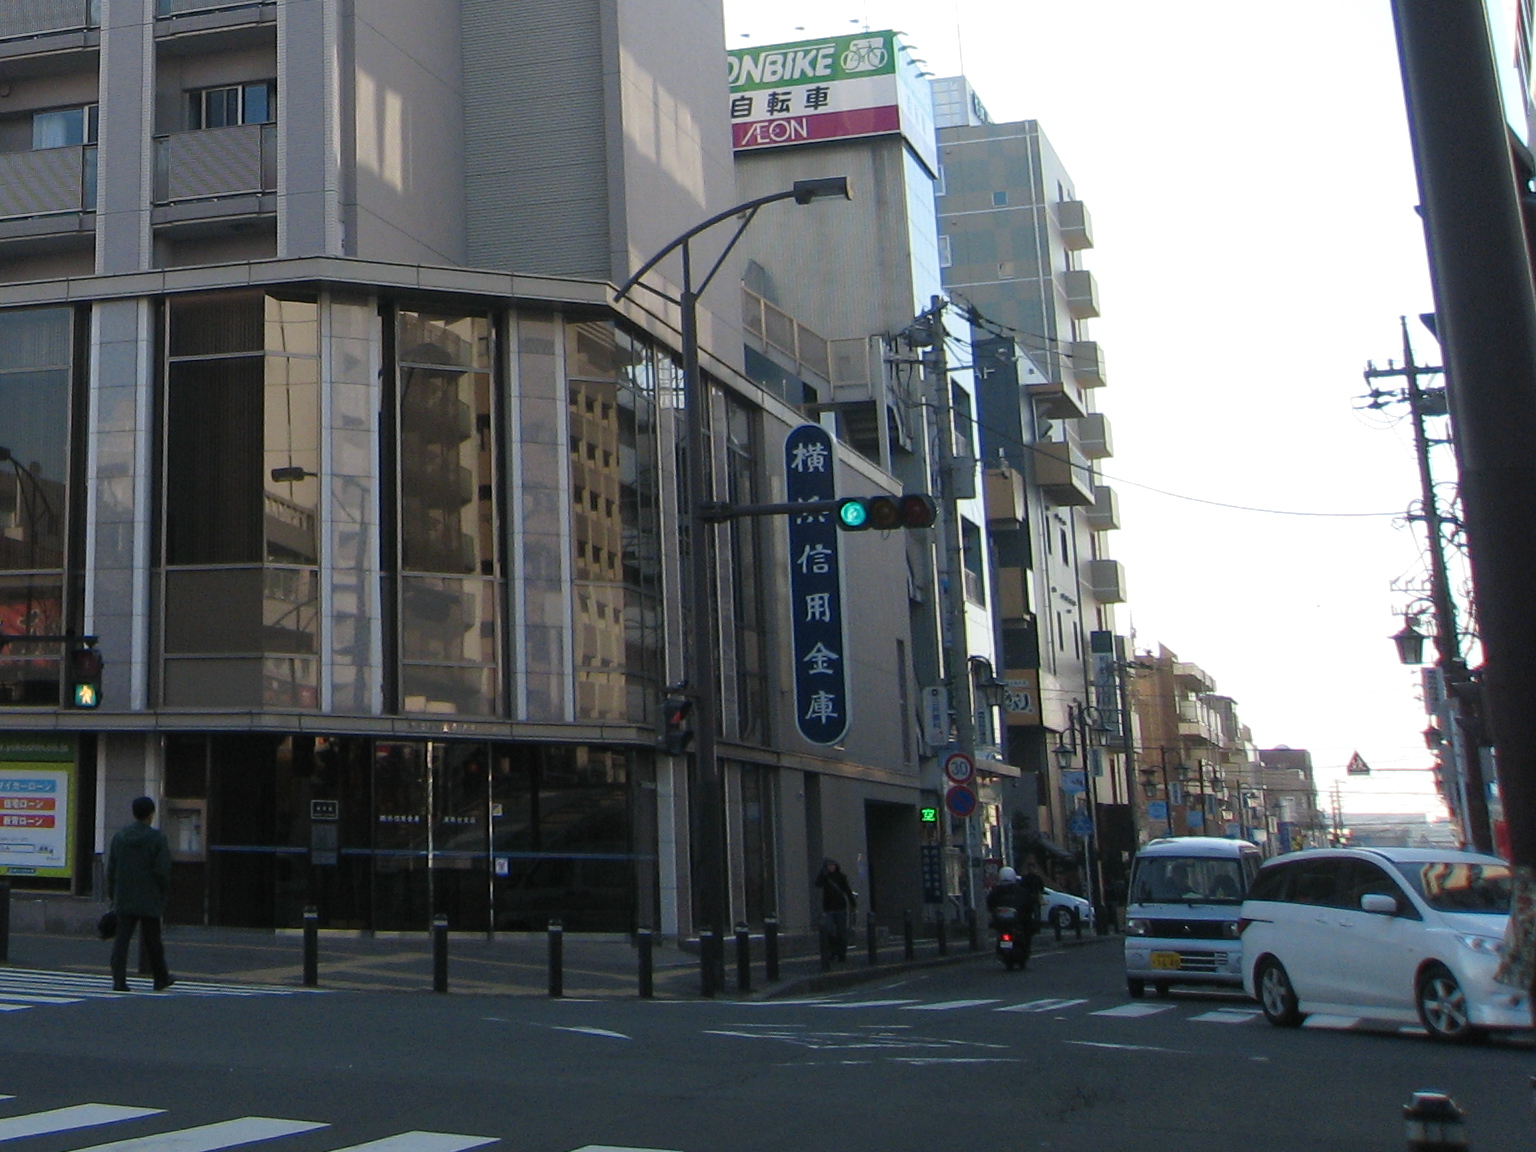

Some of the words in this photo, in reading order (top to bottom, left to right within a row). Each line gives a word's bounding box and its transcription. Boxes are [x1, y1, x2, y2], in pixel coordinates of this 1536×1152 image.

[731, 86, 830, 119] 自転車
[791, 442, 839, 725] 横浜信用金庫
[951, 760, 968, 777] 30
